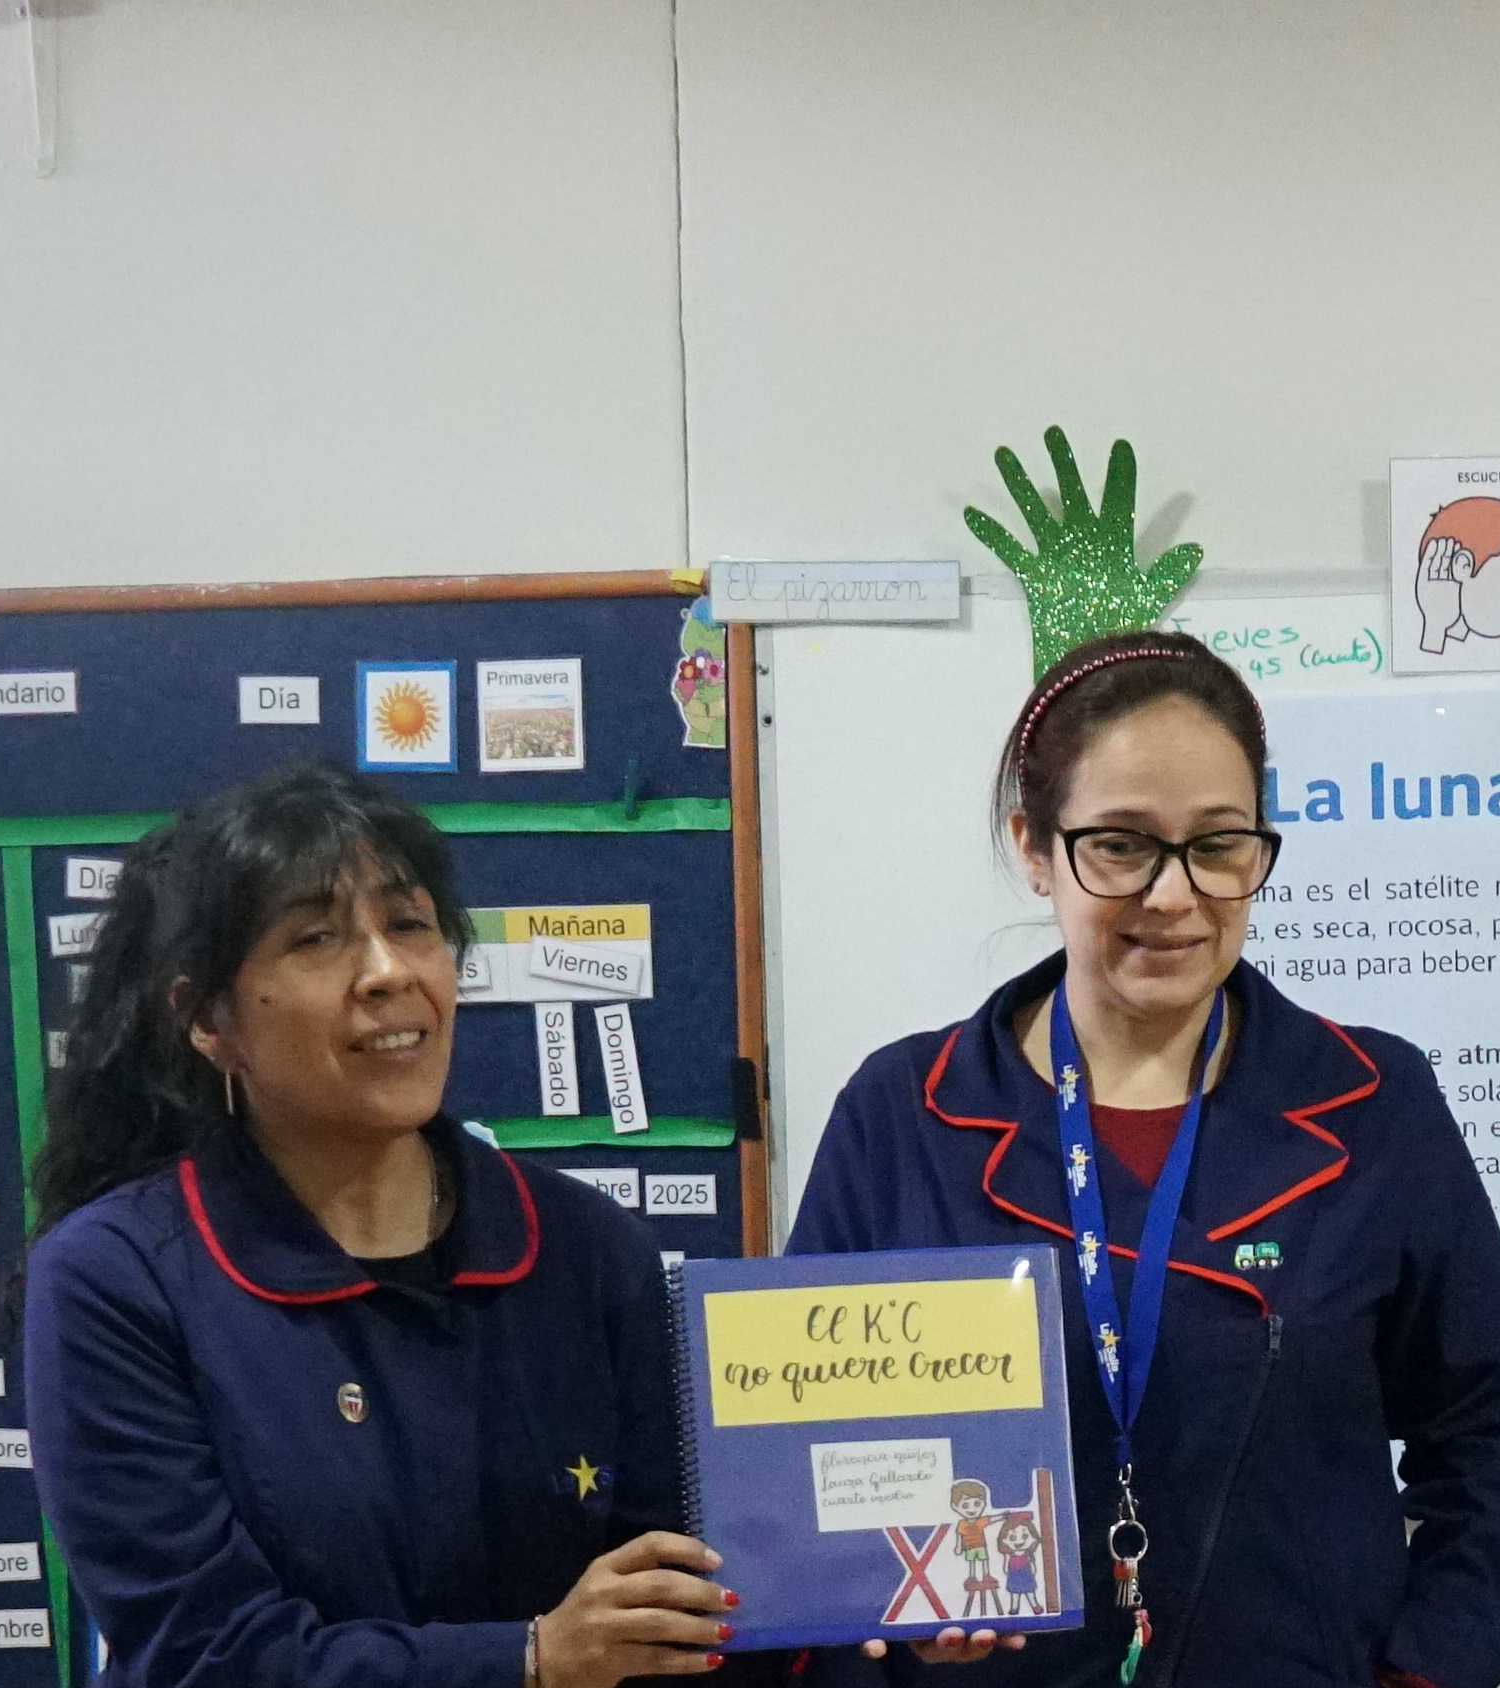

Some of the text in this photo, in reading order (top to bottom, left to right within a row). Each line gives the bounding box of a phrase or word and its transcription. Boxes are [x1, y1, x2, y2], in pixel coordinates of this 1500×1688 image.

[485, 670, 569, 688] Primavera
[258, 686, 301, 710] Día
[1264, 768, 1344, 823] La
[1306, 880, 1335, 902] es
[1348, 877, 1371, 901] el
[1385, 873, 1480, 900] satélite
[528, 913, 626, 937] Mañana
[1274, 922, 1302, 940] es
[1313, 917, 1377, 943] seca,
[1387, 914, 1481, 941] rocosa,
[542, 945, 629, 982] Viernes
[1286, 957, 1347, 982] agua
[1356, 955, 1413, 981] para
[1421, 949, 1498, 975] beber
[544, 1011, 566, 1108] Sábado
[603, 1012, 635, 1125] Domingo
[651, 1183, 709, 1205] 2025
[725, 1362, 772, 1393] no
[781, 1354, 900, 1404] quiere
